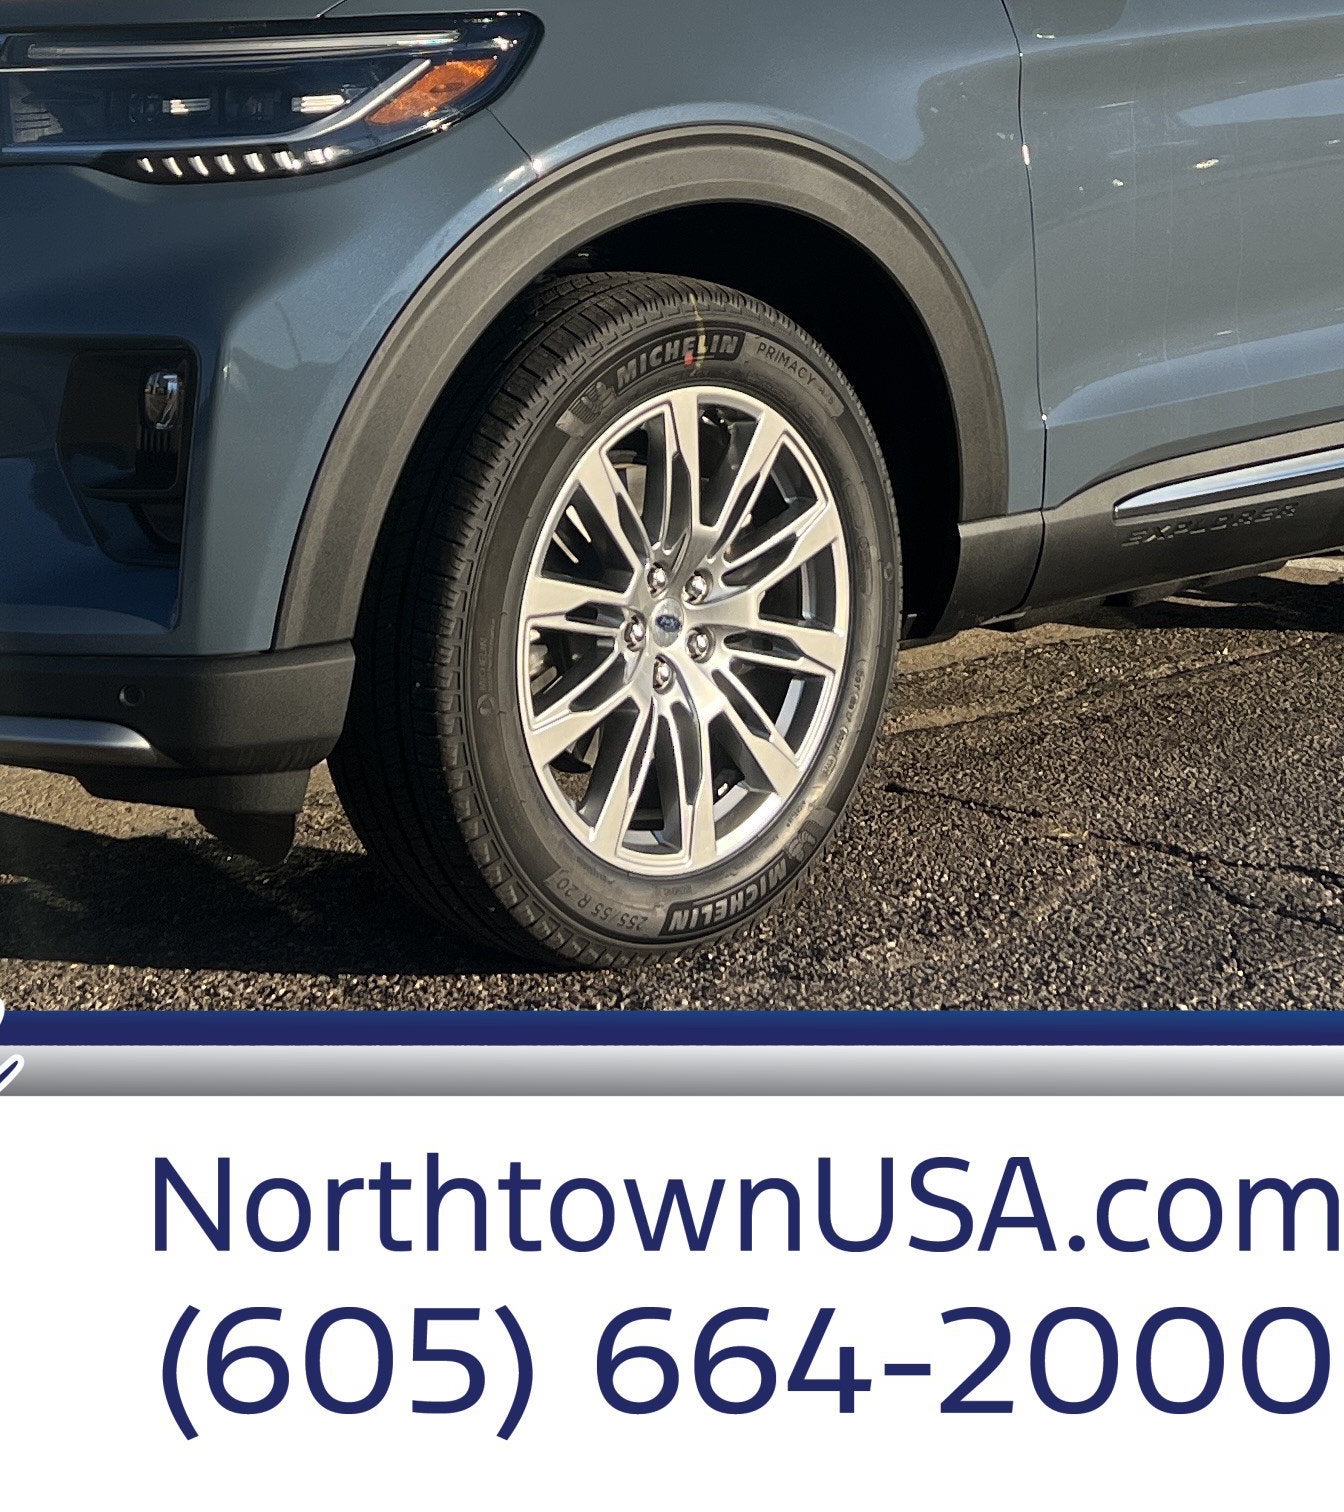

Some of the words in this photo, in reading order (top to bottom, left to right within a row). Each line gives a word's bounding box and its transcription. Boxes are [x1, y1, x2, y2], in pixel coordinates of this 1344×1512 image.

[616, 334, 739, 390] MICHELIN
[757, 341, 816, 387] PRIMACY
[668, 857, 788, 932] MICHELIN
